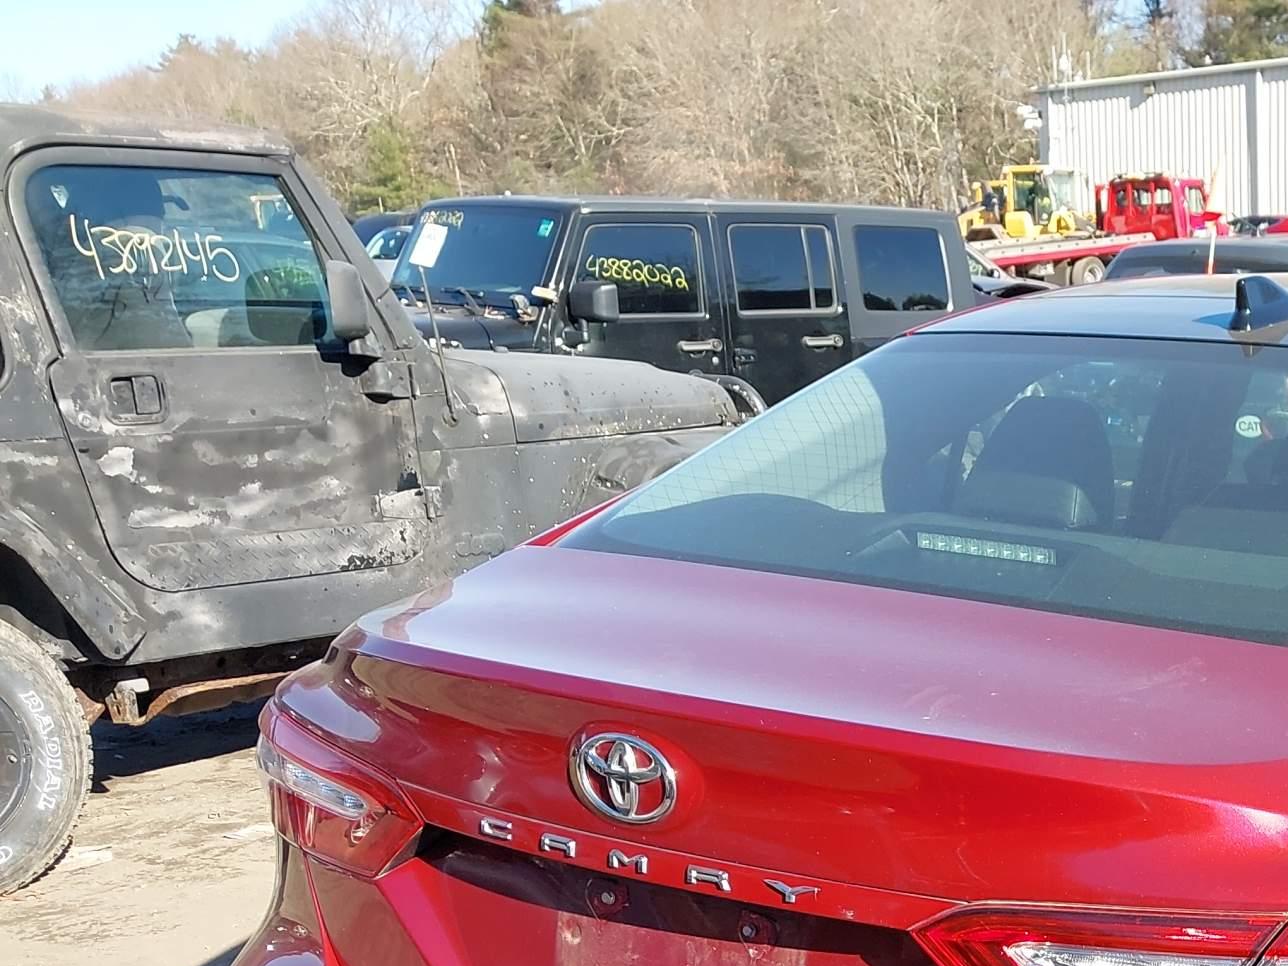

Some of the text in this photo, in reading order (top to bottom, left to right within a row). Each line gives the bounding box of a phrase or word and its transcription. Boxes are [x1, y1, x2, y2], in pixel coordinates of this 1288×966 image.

[69, 213, 241, 283] 43892145
[585, 254, 690, 292] 43882022
[19, 690, 63, 811] RADIAL
[479, 814, 822, 904] CAMRY
